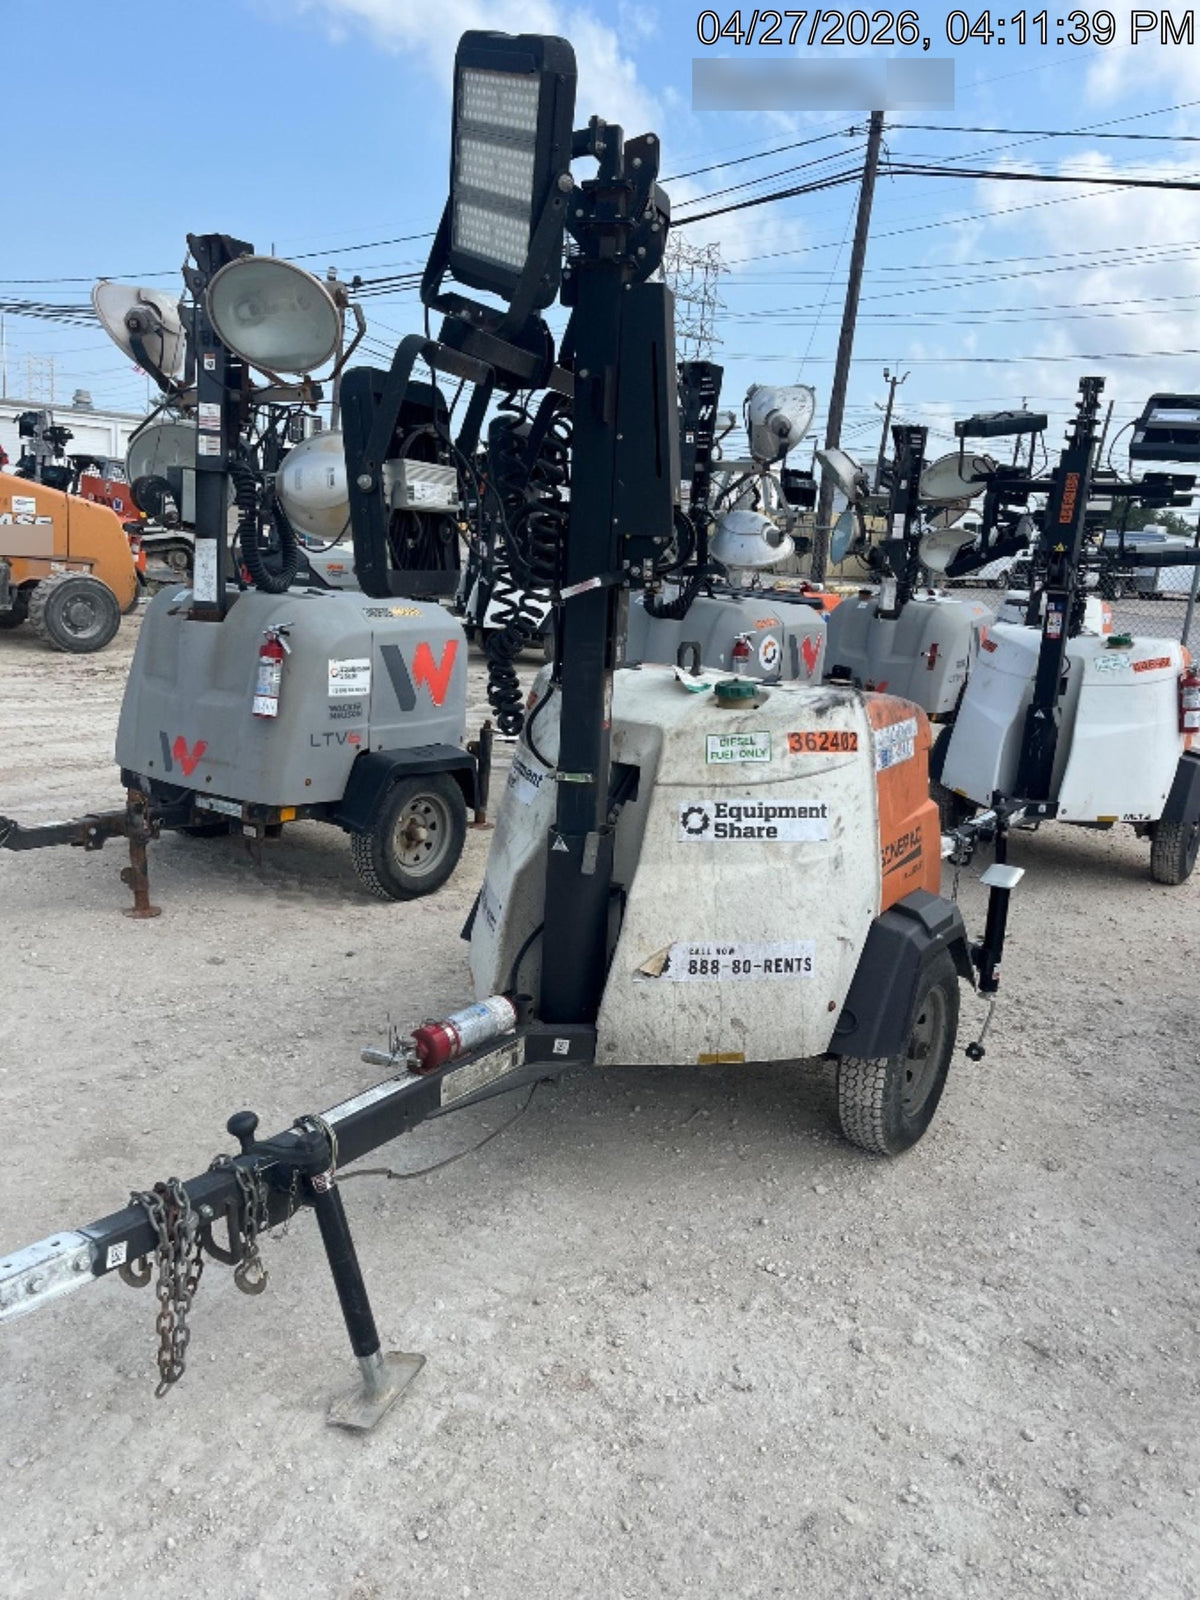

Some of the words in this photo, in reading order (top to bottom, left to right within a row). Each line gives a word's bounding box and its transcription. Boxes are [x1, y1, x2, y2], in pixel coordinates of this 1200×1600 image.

[719, 736, 756, 747] DIESEL
[790, 731, 858, 752] 362402
[710, 750, 735, 760] FUEL
[738, 749, 768, 759] ONLY
[713, 802, 828, 822] Equipment
[713, 823, 778, 839] Share
[689, 947, 712, 956] CALL
[687, 957, 812, 975] 888-80-RENTS
